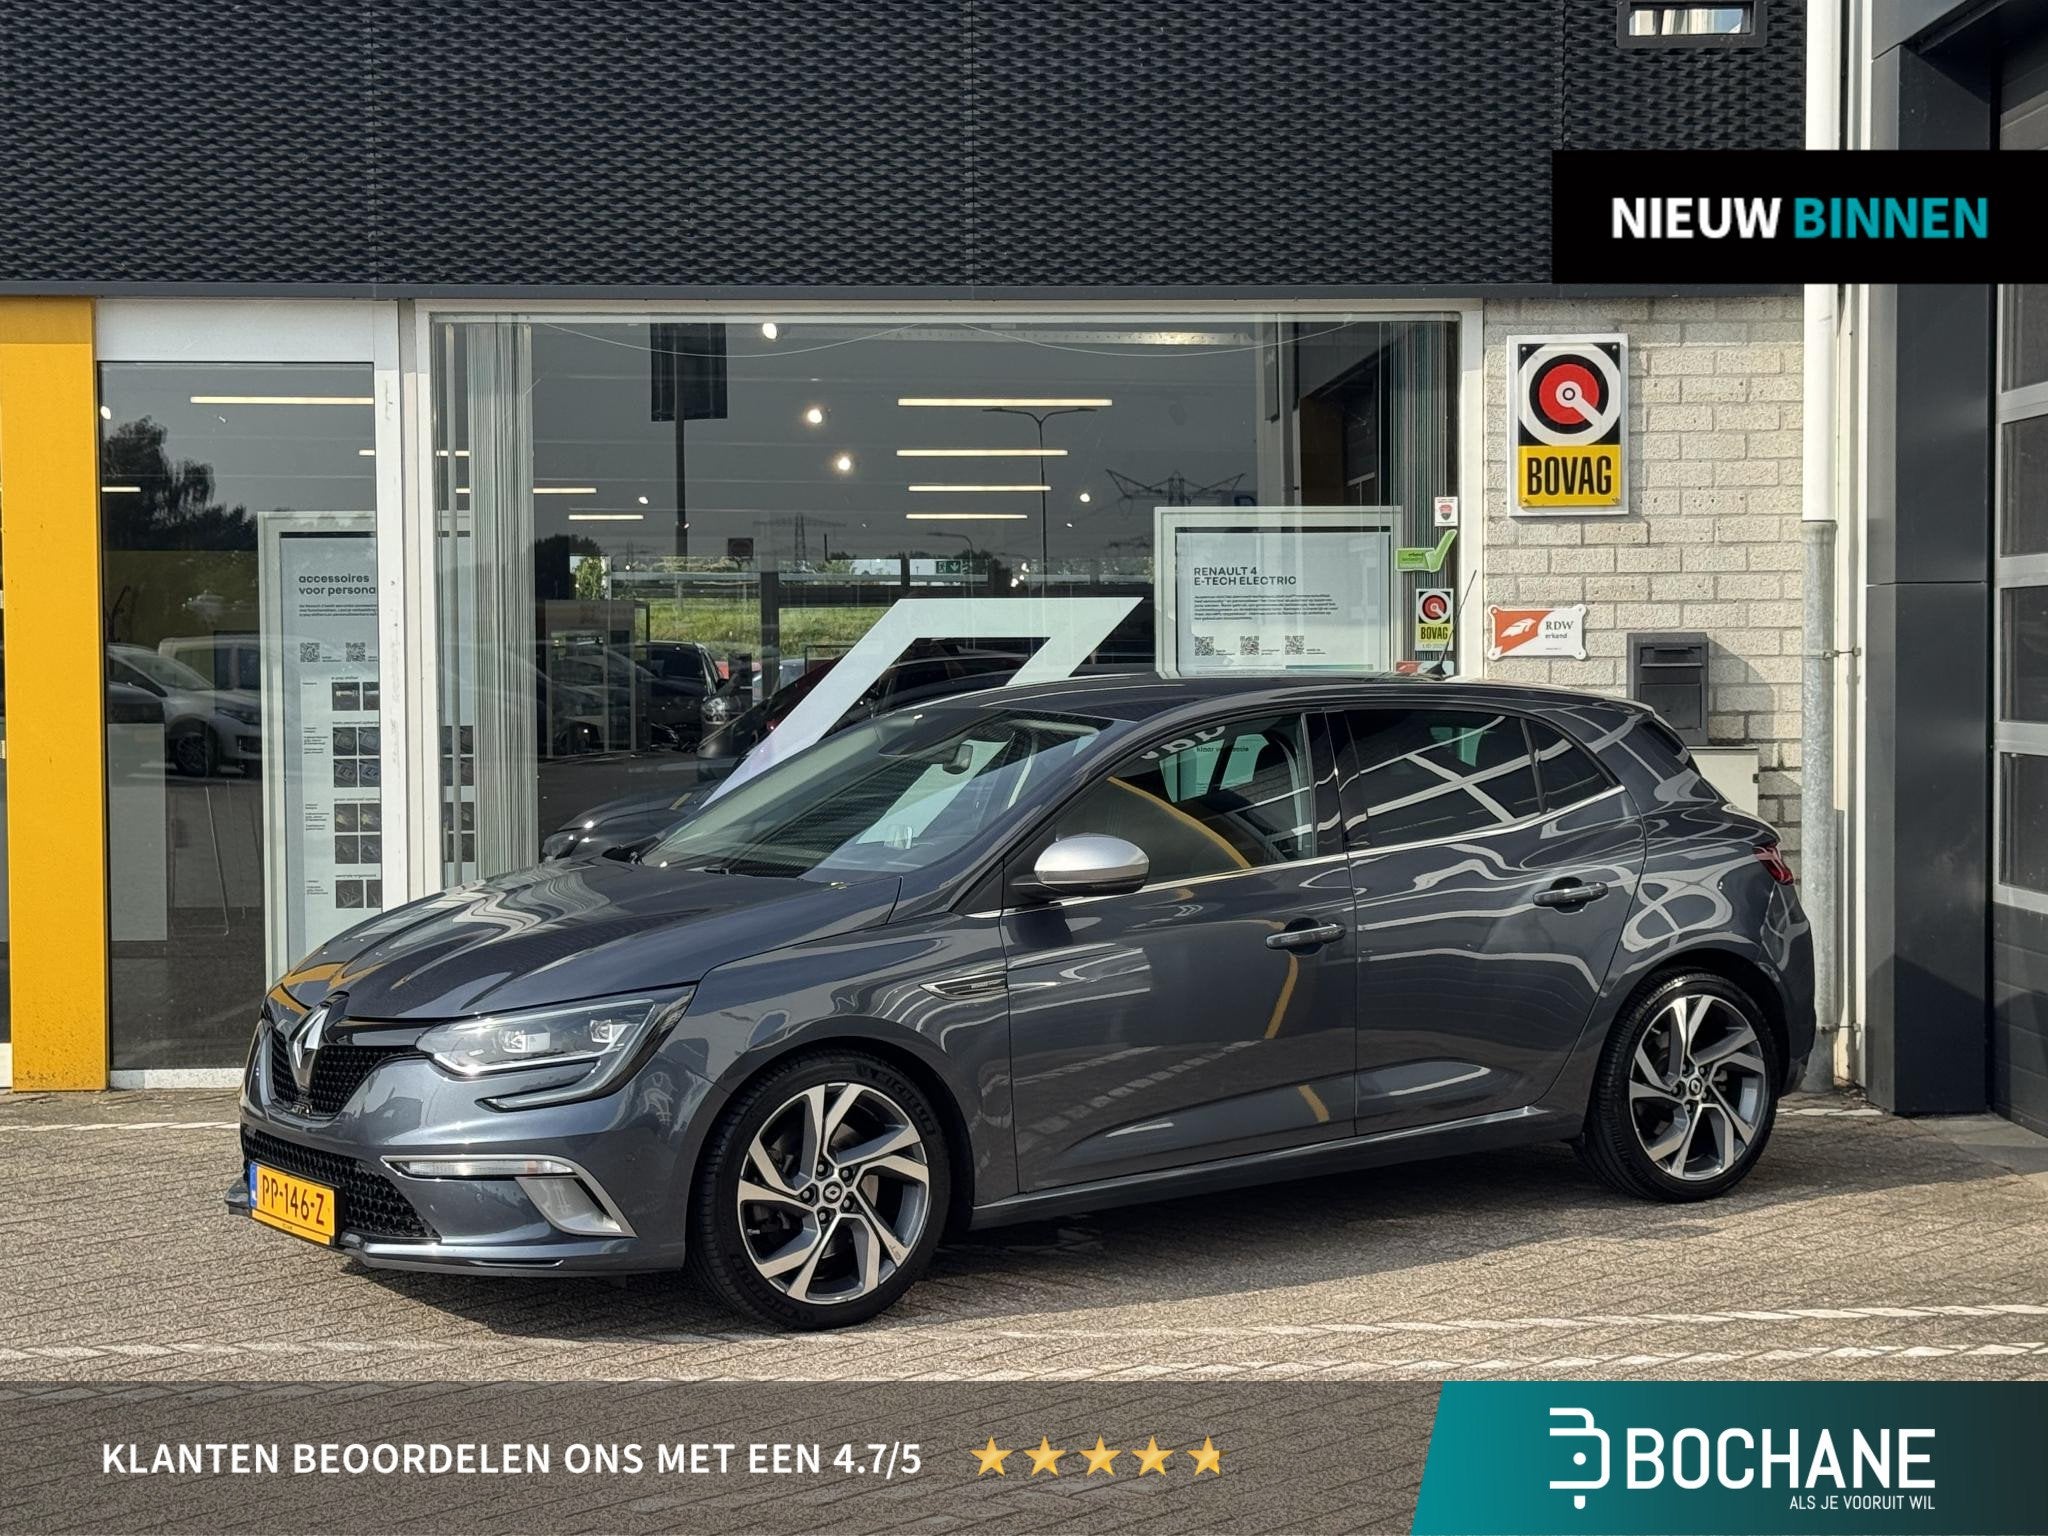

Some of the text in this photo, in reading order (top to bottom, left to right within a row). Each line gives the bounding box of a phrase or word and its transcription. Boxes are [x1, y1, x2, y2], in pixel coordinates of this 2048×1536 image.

[1527, 455, 1612, 496] BOVAG
[1193, 566, 1258, 576] RENAULT 4
[298, 573, 370, 584] accessoires
[1194, 576, 1297, 586] E-TECH ELECTRIC
[298, 587, 326, 595] voor
[1545, 620, 1574, 631] RDW
[1420, 626, 1449, 640] BOVAG
[261, 1173, 325, 1227] PP-146-Z
